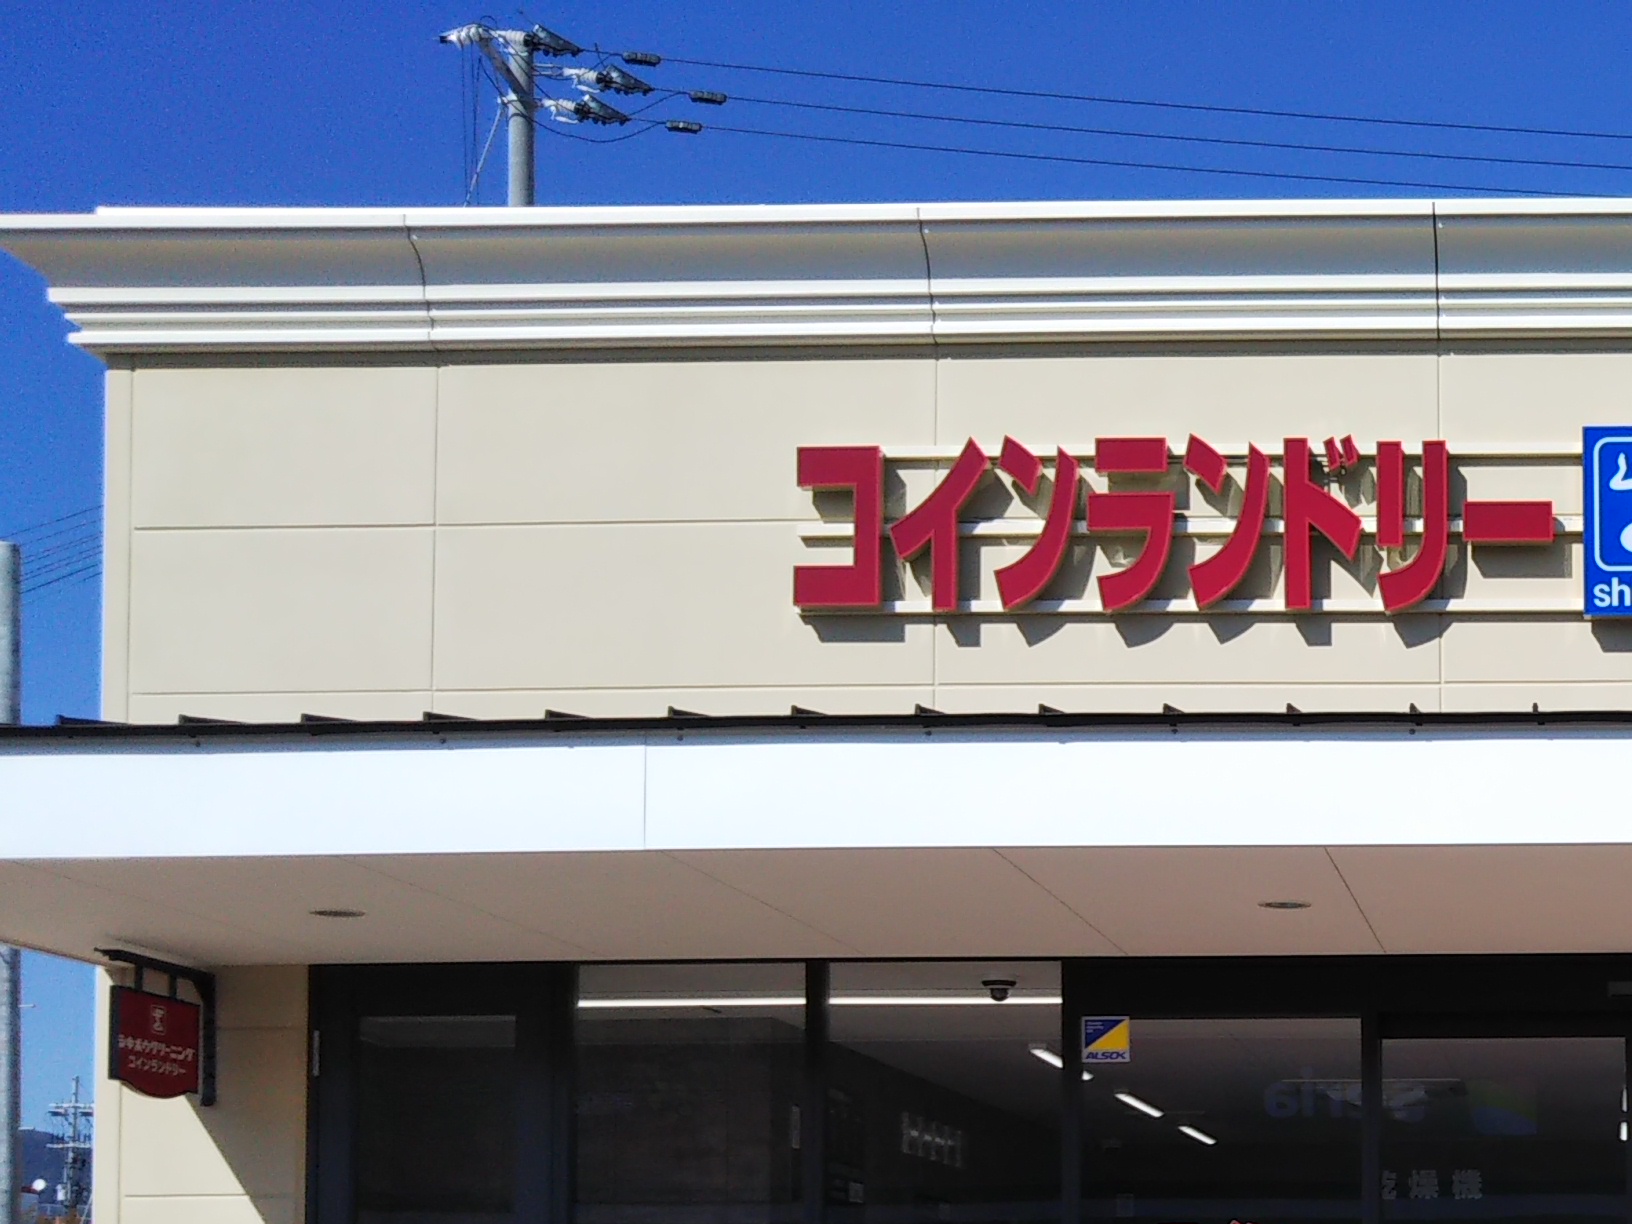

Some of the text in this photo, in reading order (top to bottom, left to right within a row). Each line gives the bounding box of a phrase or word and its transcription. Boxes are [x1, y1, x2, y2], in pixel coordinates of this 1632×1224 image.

[793, 433, 1554, 614] コインランドリー
[128, 1055, 187, 1077] コインランドリー
[1086, 1051, 1127, 1060] ALSOK
